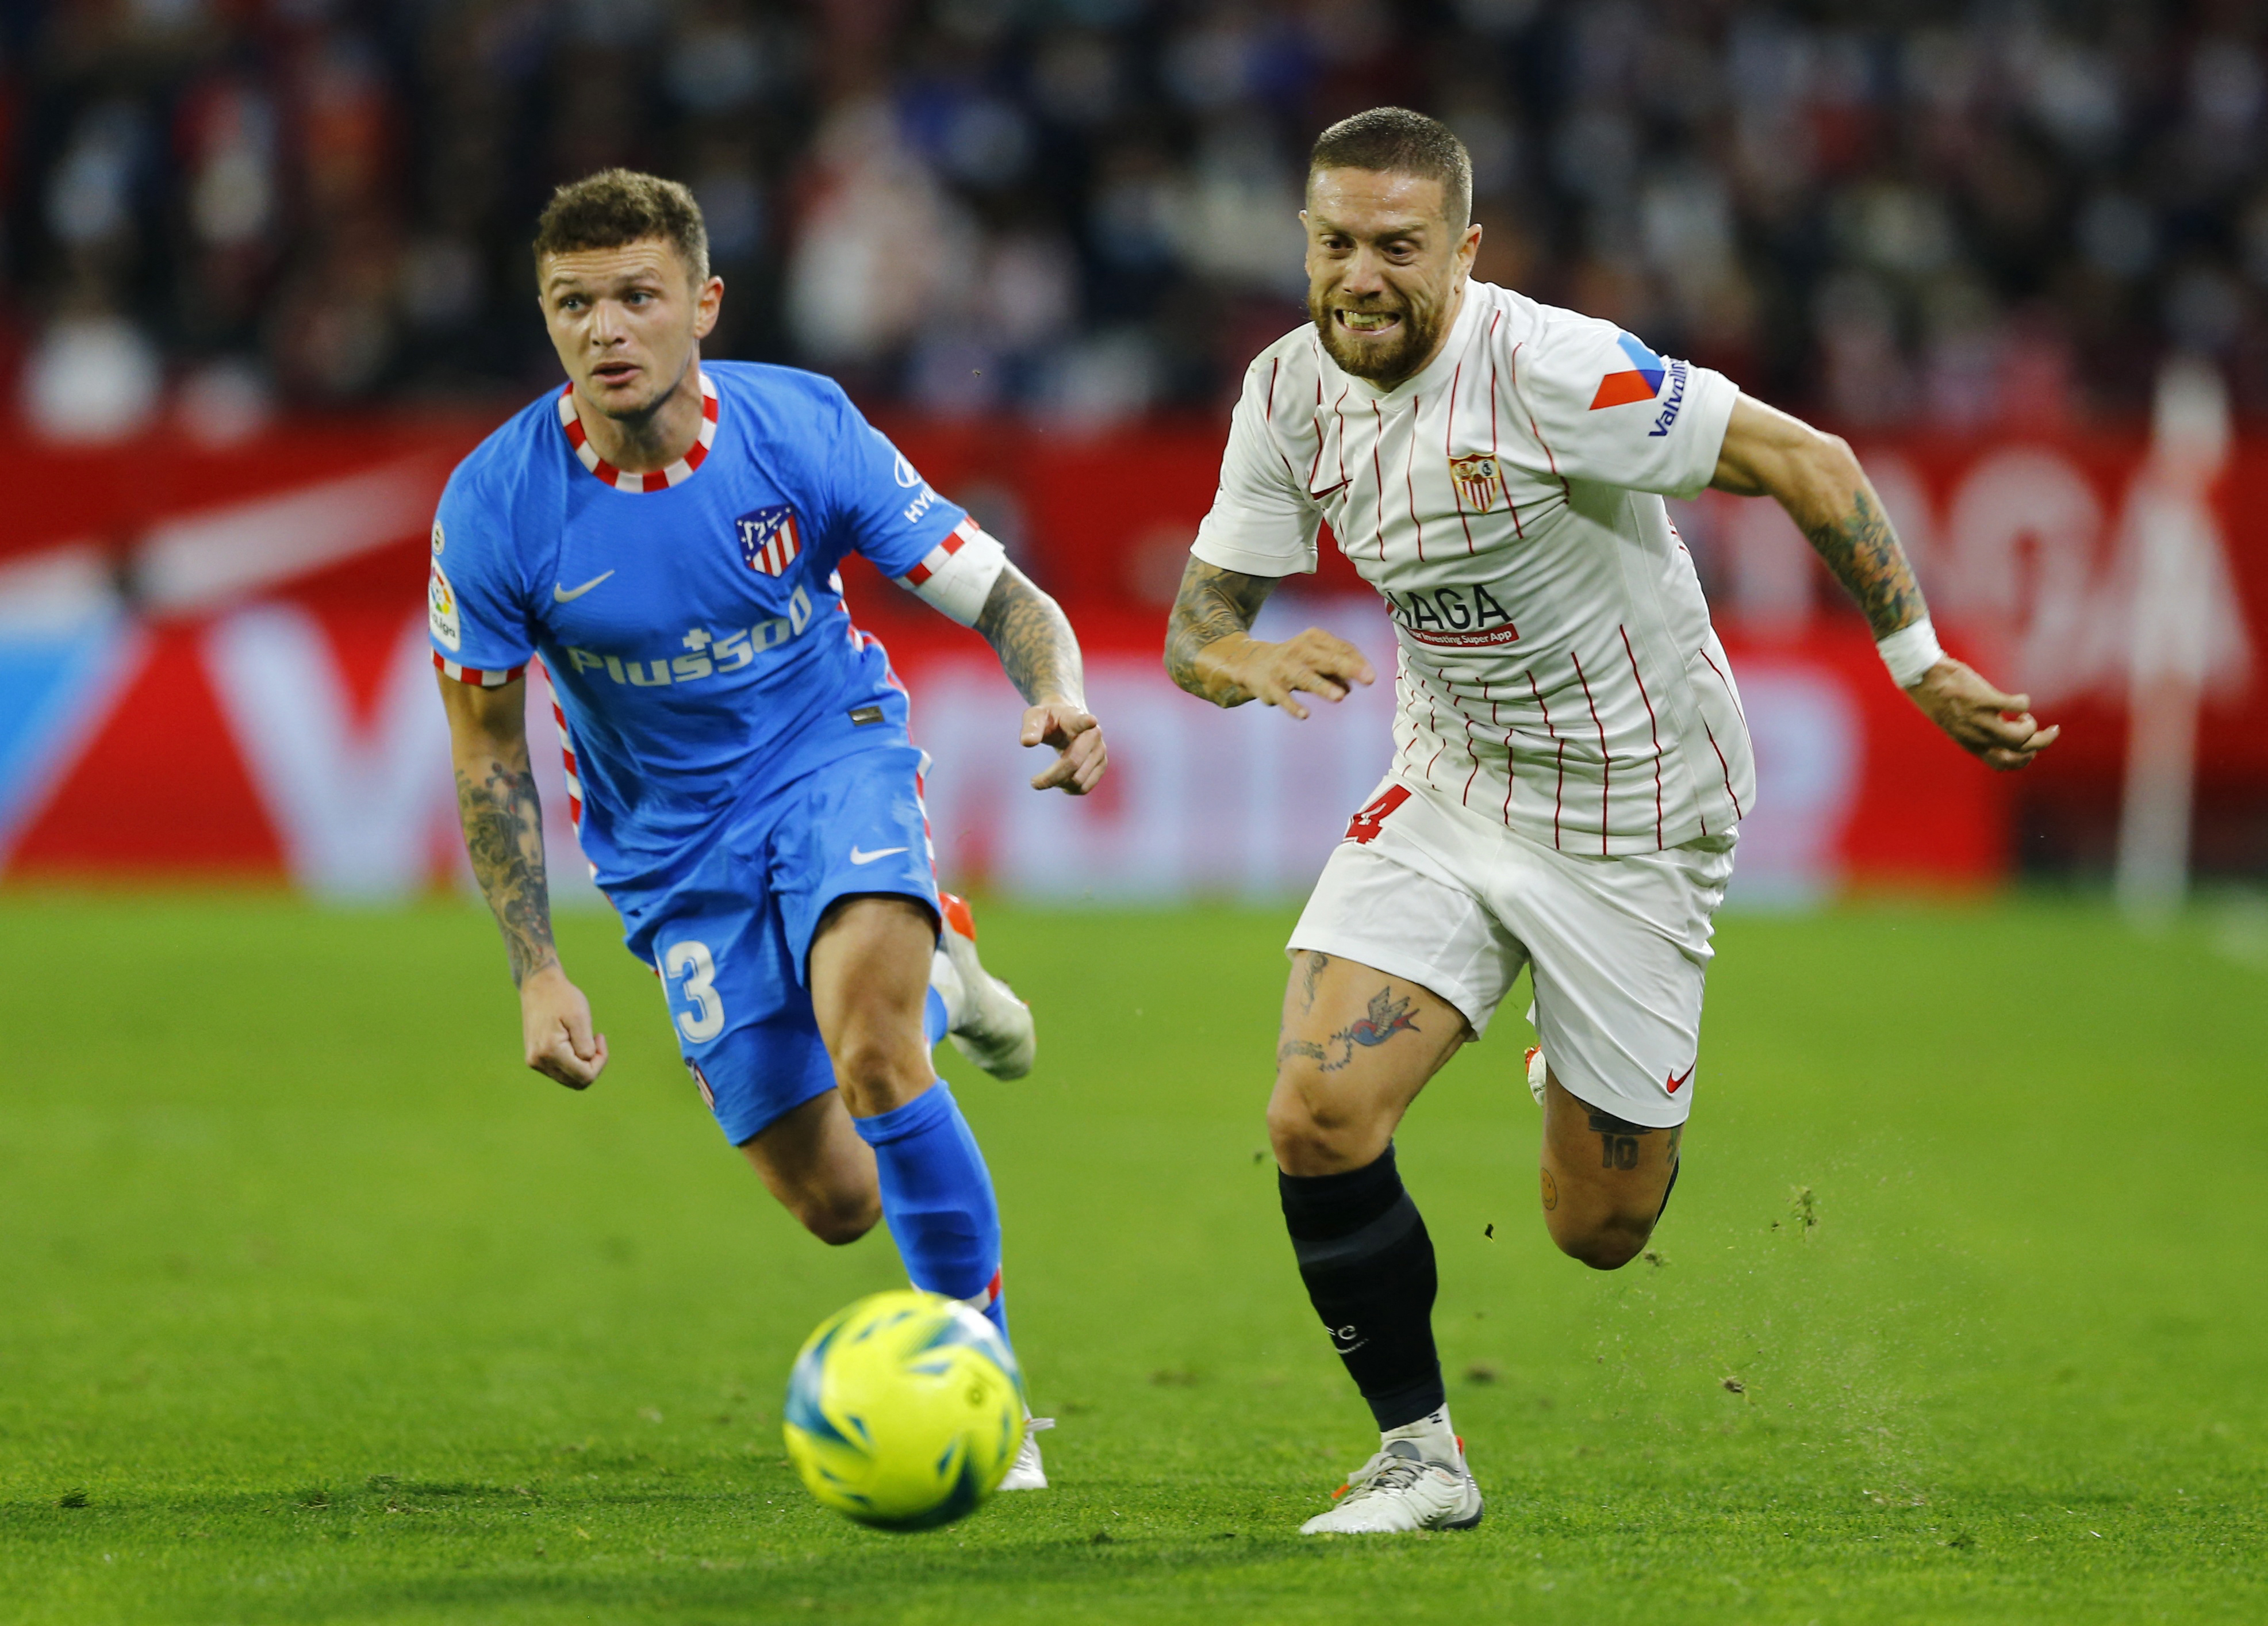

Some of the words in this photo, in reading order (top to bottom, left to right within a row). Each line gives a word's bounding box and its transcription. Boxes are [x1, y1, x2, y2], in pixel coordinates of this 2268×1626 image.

[566, 585, 812, 687] Plus500
[1421, 632, 1463, 645] Investing
[1461, 635, 1489, 645] Super
[1490, 630, 1513, 642] App
[666, 940, 725, 1044] 3
[1602, 1133, 1638, 1171] 10
